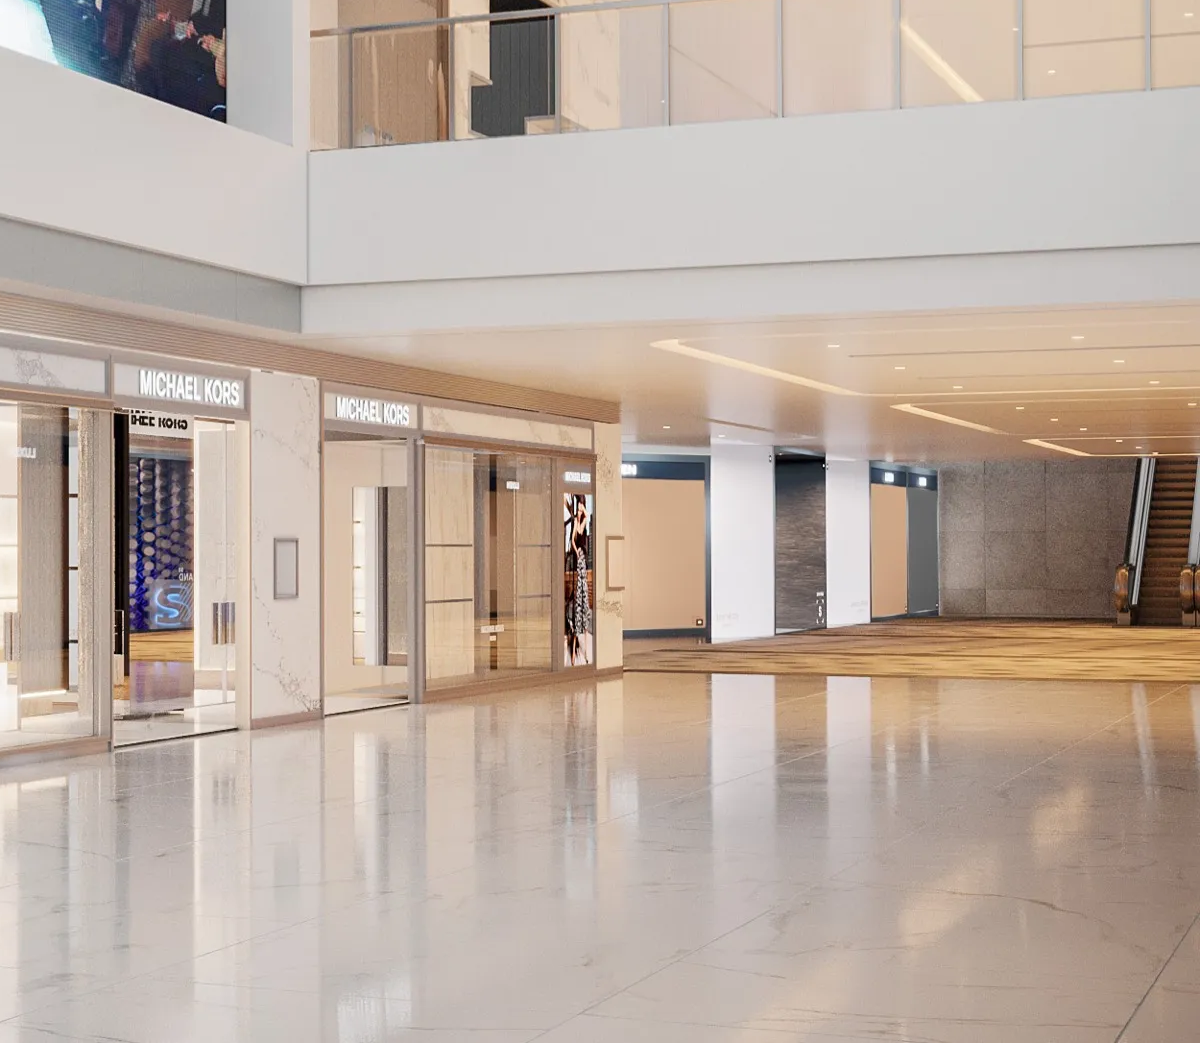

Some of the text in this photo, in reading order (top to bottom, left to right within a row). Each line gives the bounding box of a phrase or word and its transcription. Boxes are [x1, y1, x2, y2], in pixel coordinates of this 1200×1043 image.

[138, 369, 240, 407] MICHAEL KORS
[335, 396, 410, 427] MICHAEL KORS
